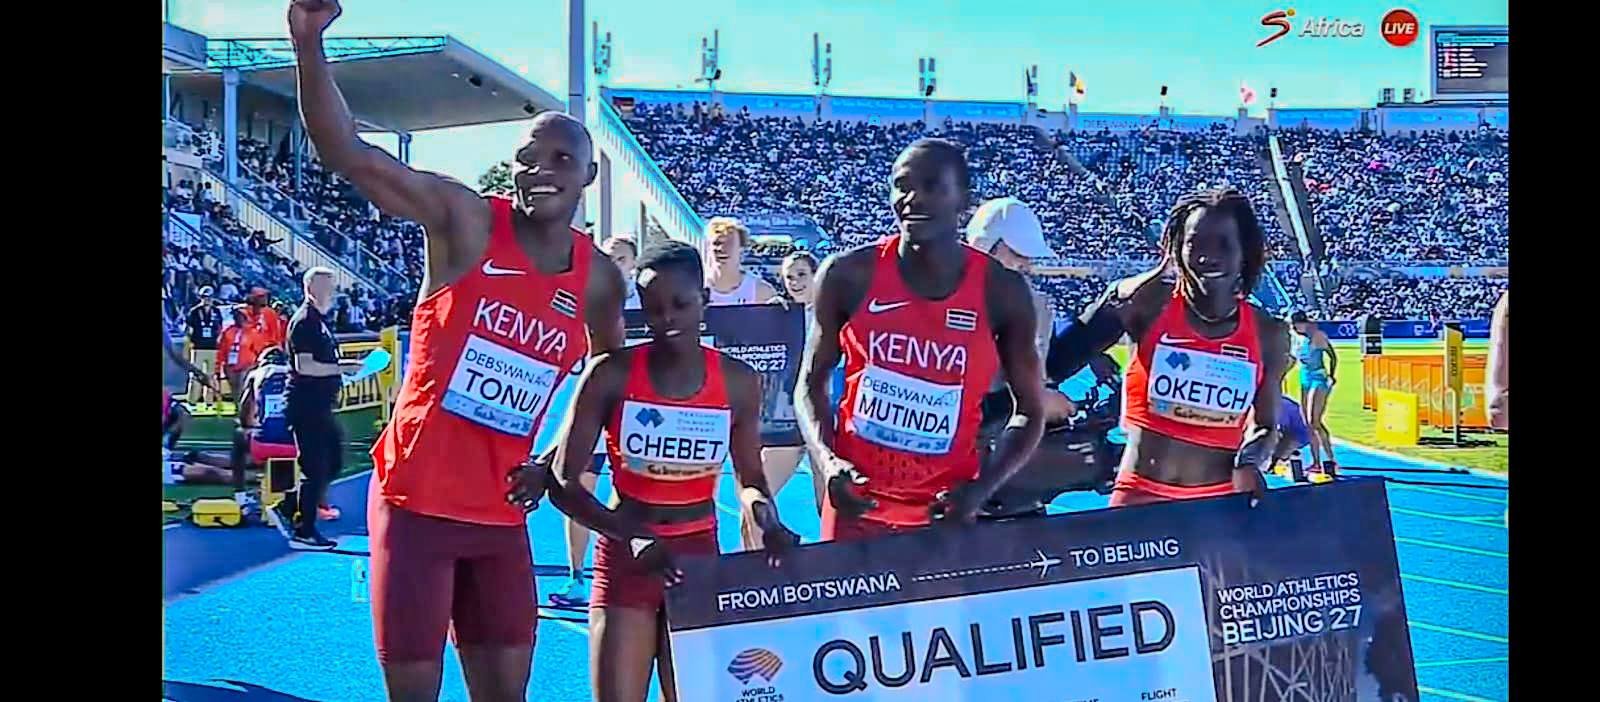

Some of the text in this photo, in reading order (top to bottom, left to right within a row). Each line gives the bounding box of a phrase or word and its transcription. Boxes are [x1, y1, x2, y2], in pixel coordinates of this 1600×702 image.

[473, 297, 566, 361] KENYA
[769, 359, 786, 371] 27
[868, 330, 967, 374] KENYA
[466, 368, 541, 414] TONUI
[1155, 375, 1248, 410] OKETCH
[859, 394, 950, 434] MUTINDA
[626, 433, 723, 460] CHEBET
[1070, 538, 1180, 567] TO BEIJING
[718, 573, 900, 611] FROM BOTSWANA
[1218, 573, 1359, 603] WORLD ATHLETICS
[1219, 588, 1361, 620] CHAMPIONSHIPS
[1221, 604, 1362, 645] BEIJING 27
[813, 600, 1177, 695] QUALIFIED
[741, 686, 776, 697] WORLD
[1141, 688, 1177, 700] FLIGHT
